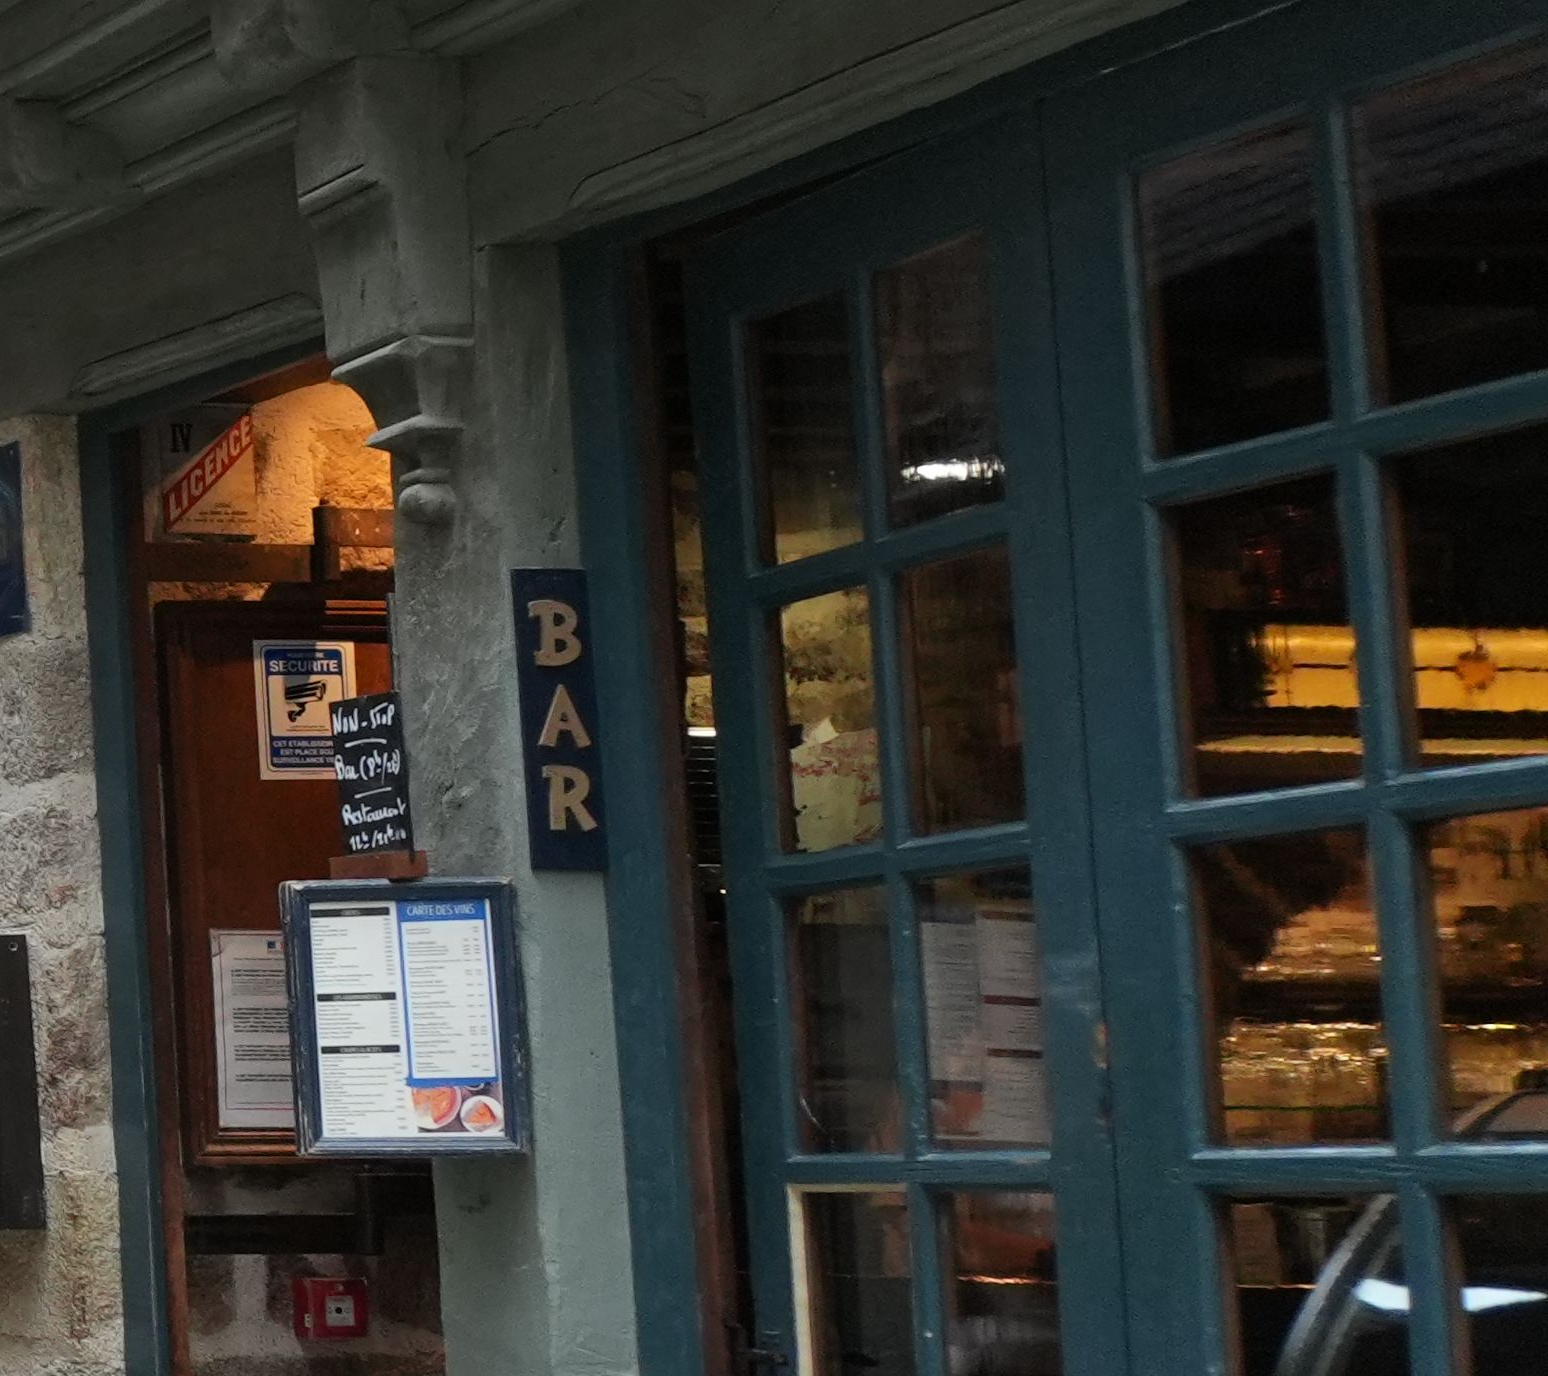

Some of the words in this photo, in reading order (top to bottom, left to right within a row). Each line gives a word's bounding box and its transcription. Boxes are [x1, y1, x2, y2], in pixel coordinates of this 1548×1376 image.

[169, 415, 251, 522] LICENCE
[528, 599, 598, 832] BAR
[436, 904, 453, 915] DES
